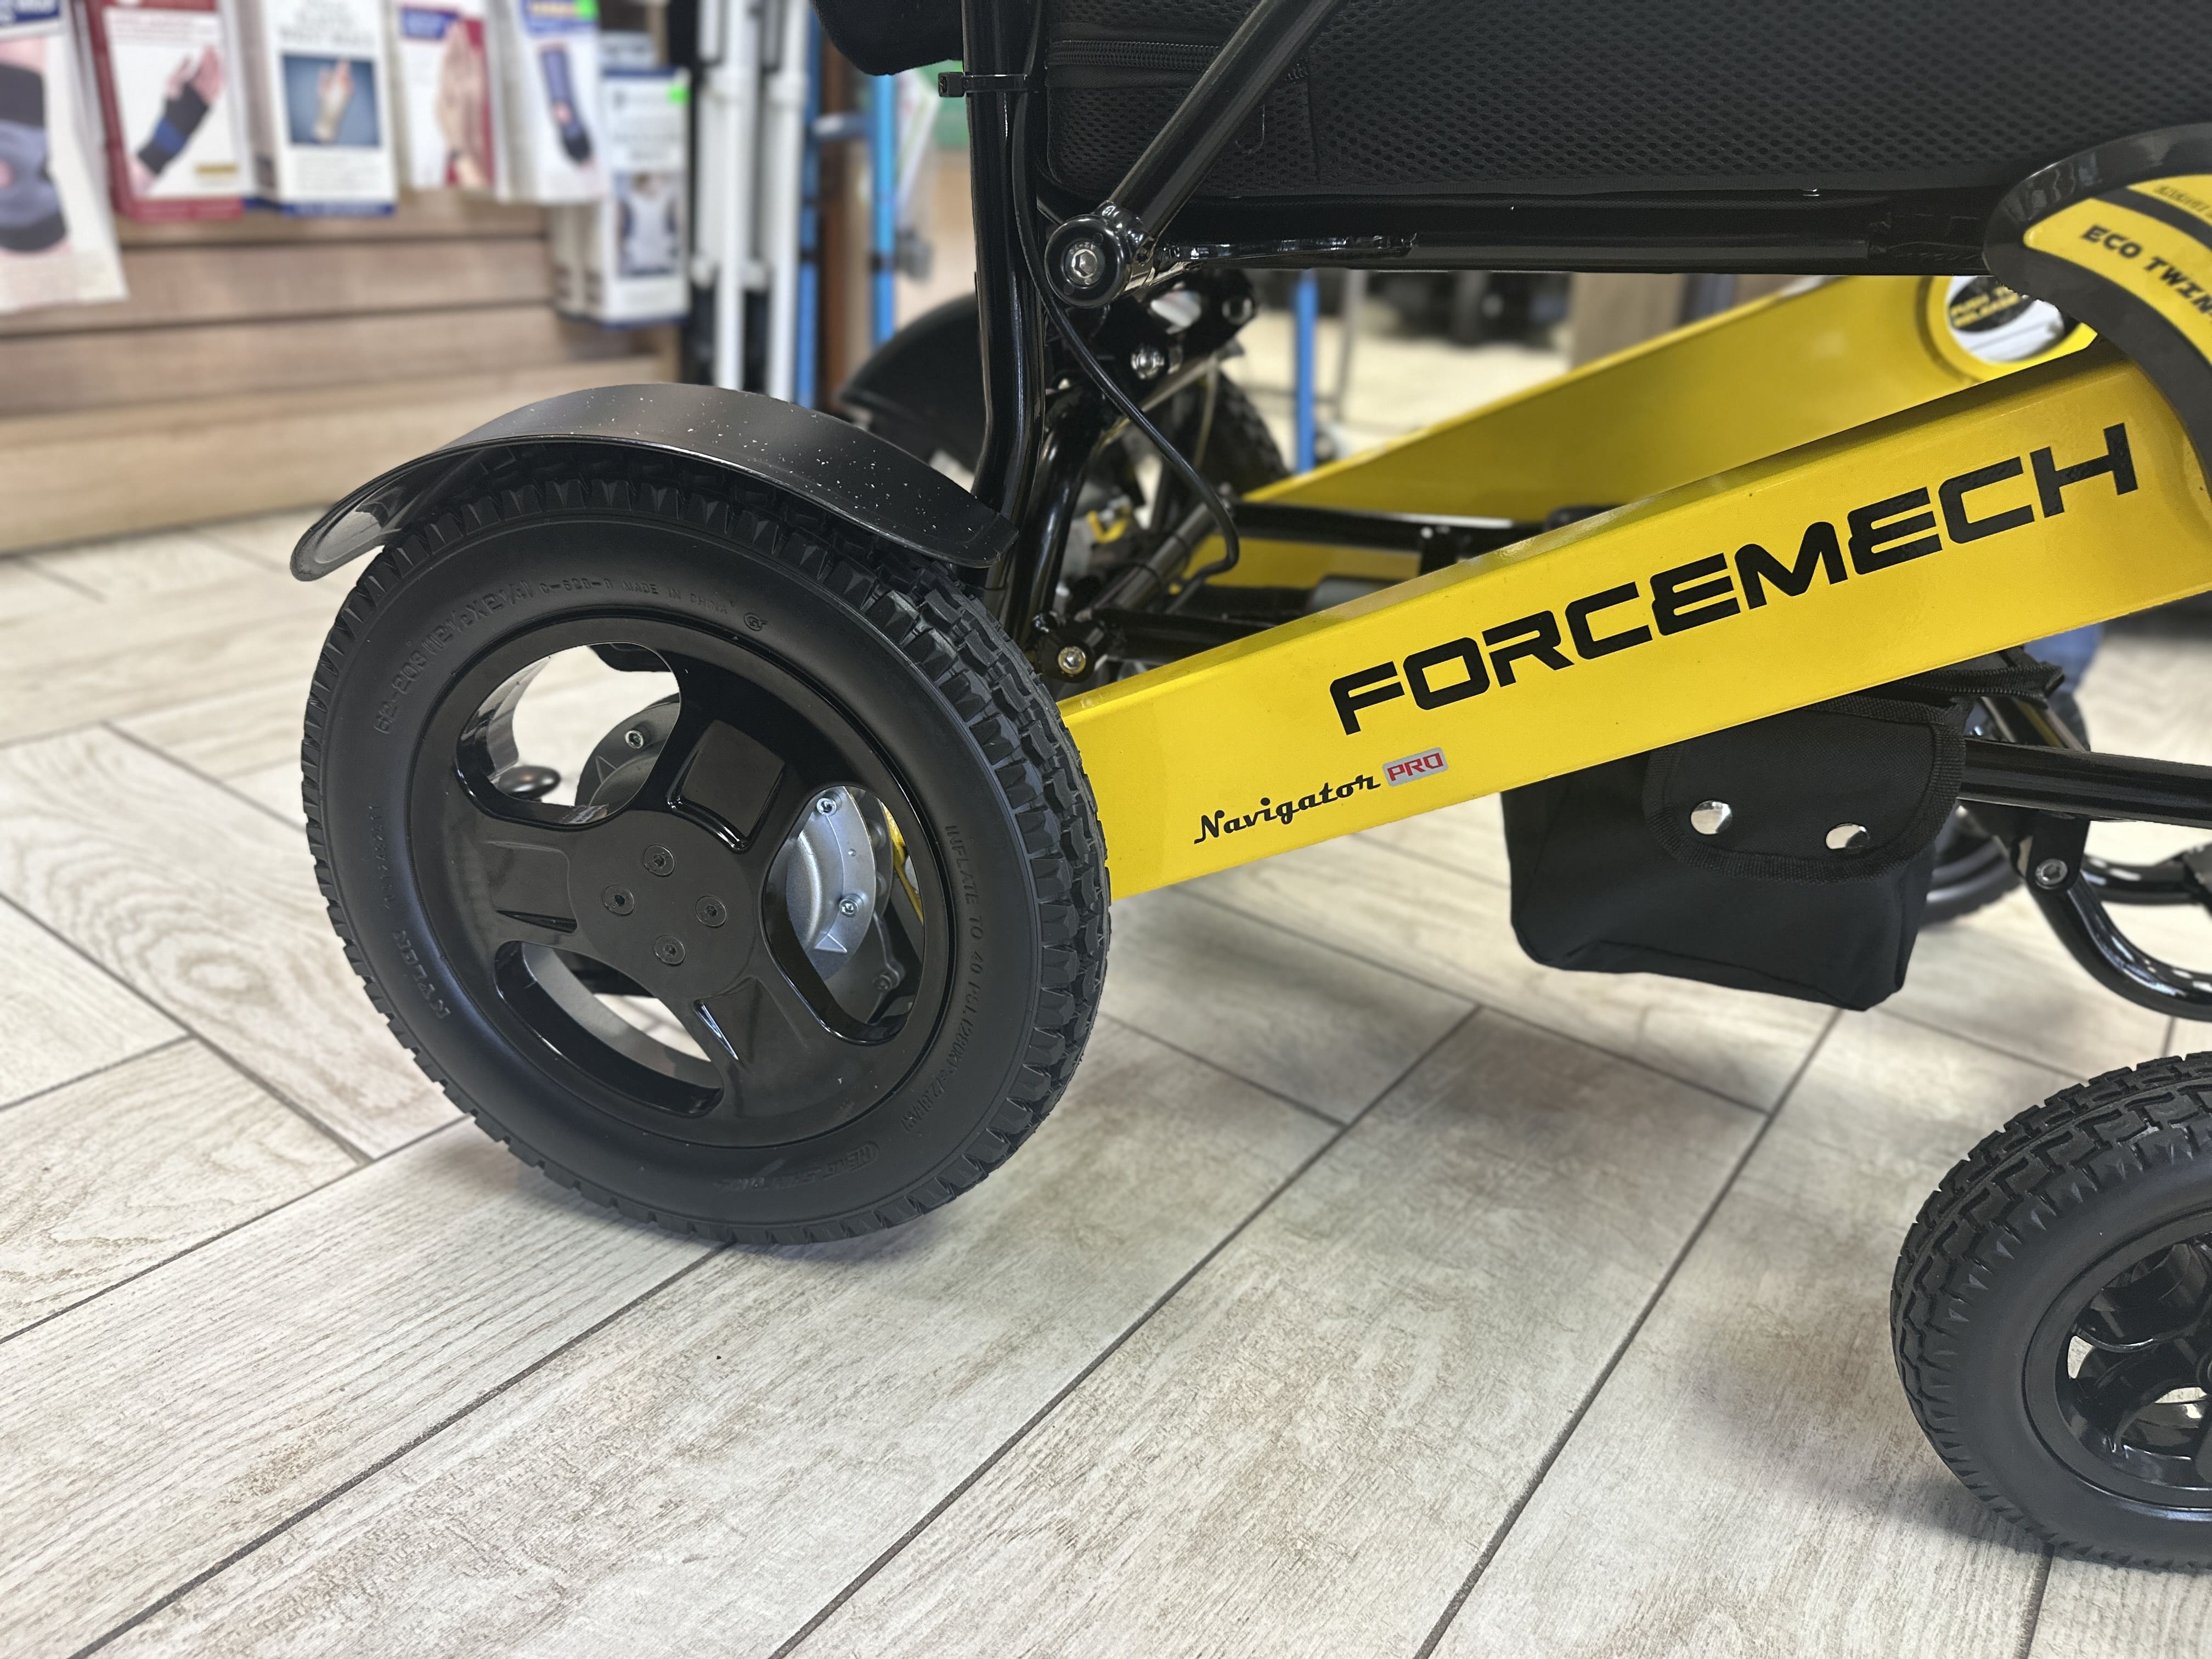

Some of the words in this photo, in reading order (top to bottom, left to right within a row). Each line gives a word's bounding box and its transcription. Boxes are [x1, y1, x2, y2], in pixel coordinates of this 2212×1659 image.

[2080, 224, 2142, 258] ECO
[2144, 256, 2212, 315] TWIN
[622, 579, 659, 595] MADE
[667, 587, 681, 600] IN
[689, 592, 729, 615] CHINA
[1330, 423, 2138, 736] FORCEMECH
[1194, 774, 1381, 845] Navigator
[1387, 752, 1443, 781] PRO
[944, 825, 979, 905] INFLATE
[968, 915, 984, 941] TO
[969, 950, 984, 975] 40
